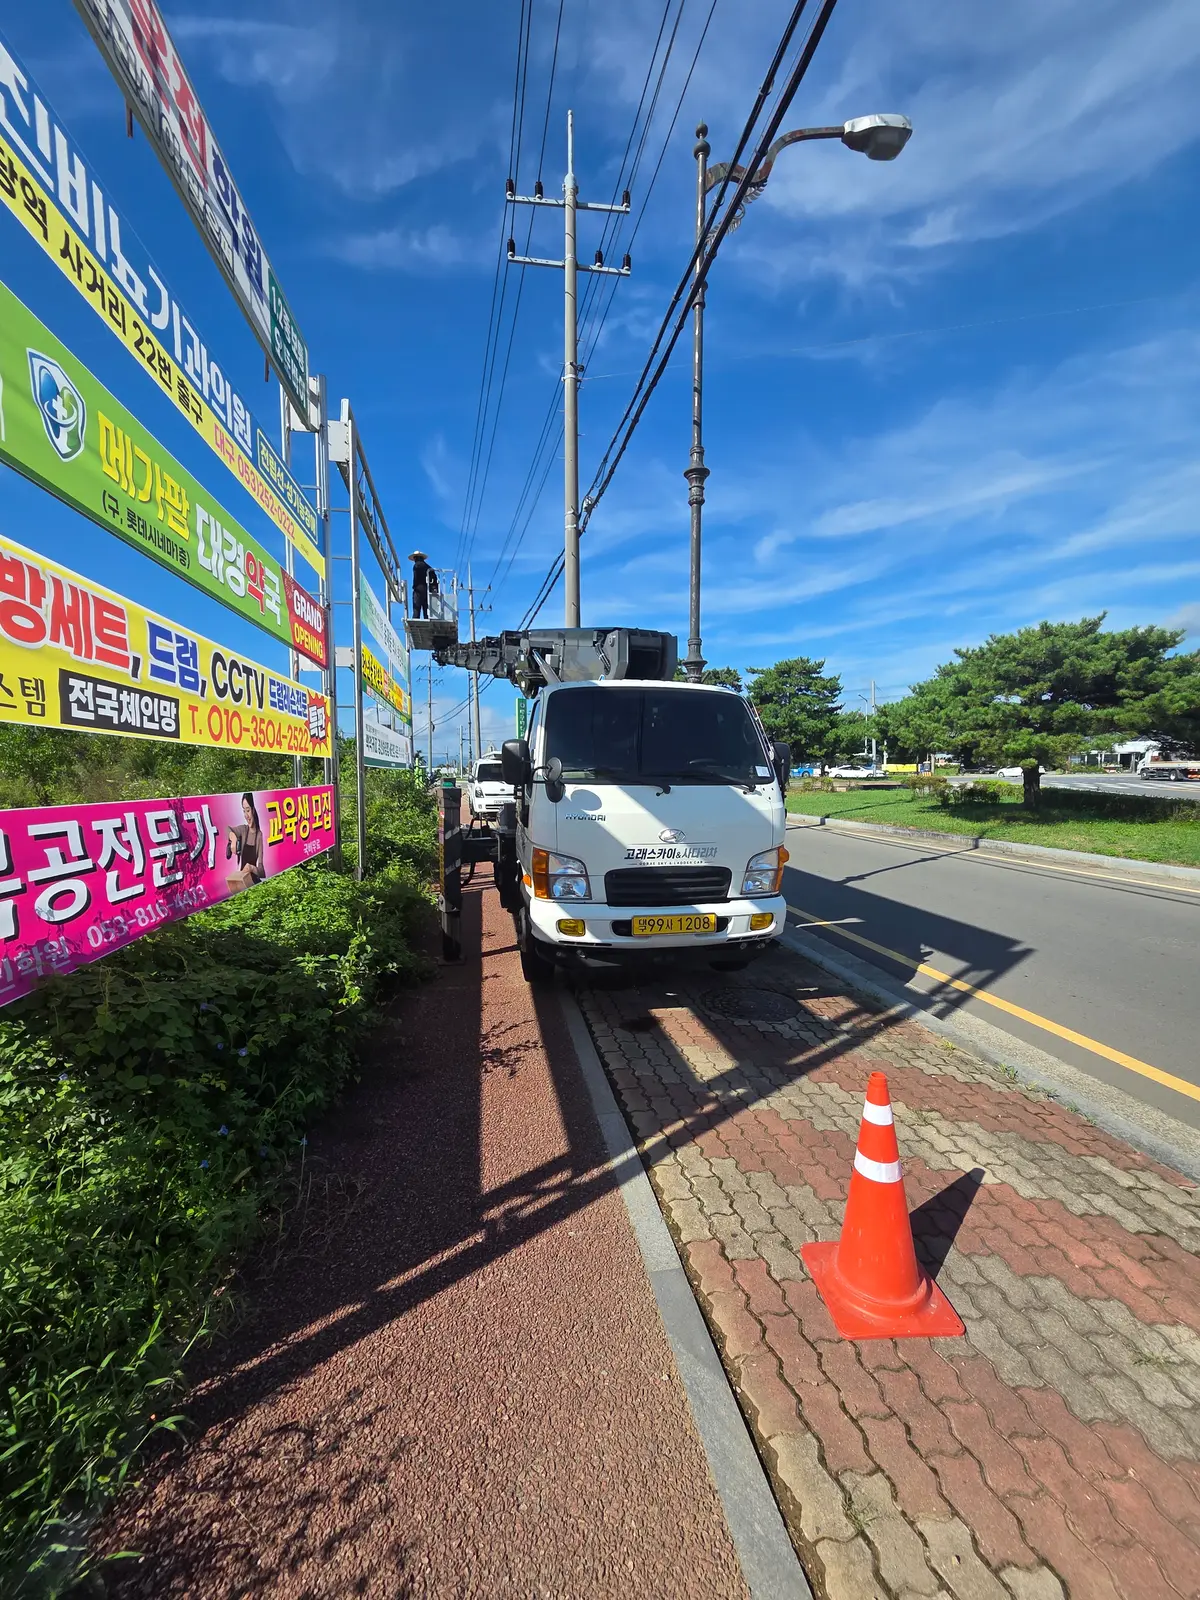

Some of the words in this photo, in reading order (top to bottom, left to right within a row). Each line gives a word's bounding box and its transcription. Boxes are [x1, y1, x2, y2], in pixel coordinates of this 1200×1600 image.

[60, 229, 127, 336] 사거리
[132, 319, 173, 392] 22번
[176, 375, 203, 425] 출구
[214, 422, 235, 463] 대구
[237, 454, 296, 541] 053)252-0222
[98, 410, 190, 541] 메가팜
[196, 503, 282, 626] 대경약국
[293, 589, 322, 634] GRAND
[294, 622, 323, 660] OPENING
[211, 651, 265, 710] CCTV
[69, 677, 176, 733] 전국체인망
[188, 704, 203, 735] T.
[207, 704, 309, 753] 010-3504-2522
[265, 793, 311, 845] 교육생
[311, 791, 332, 831] 모집
[678, 916, 710, 931] 1208
